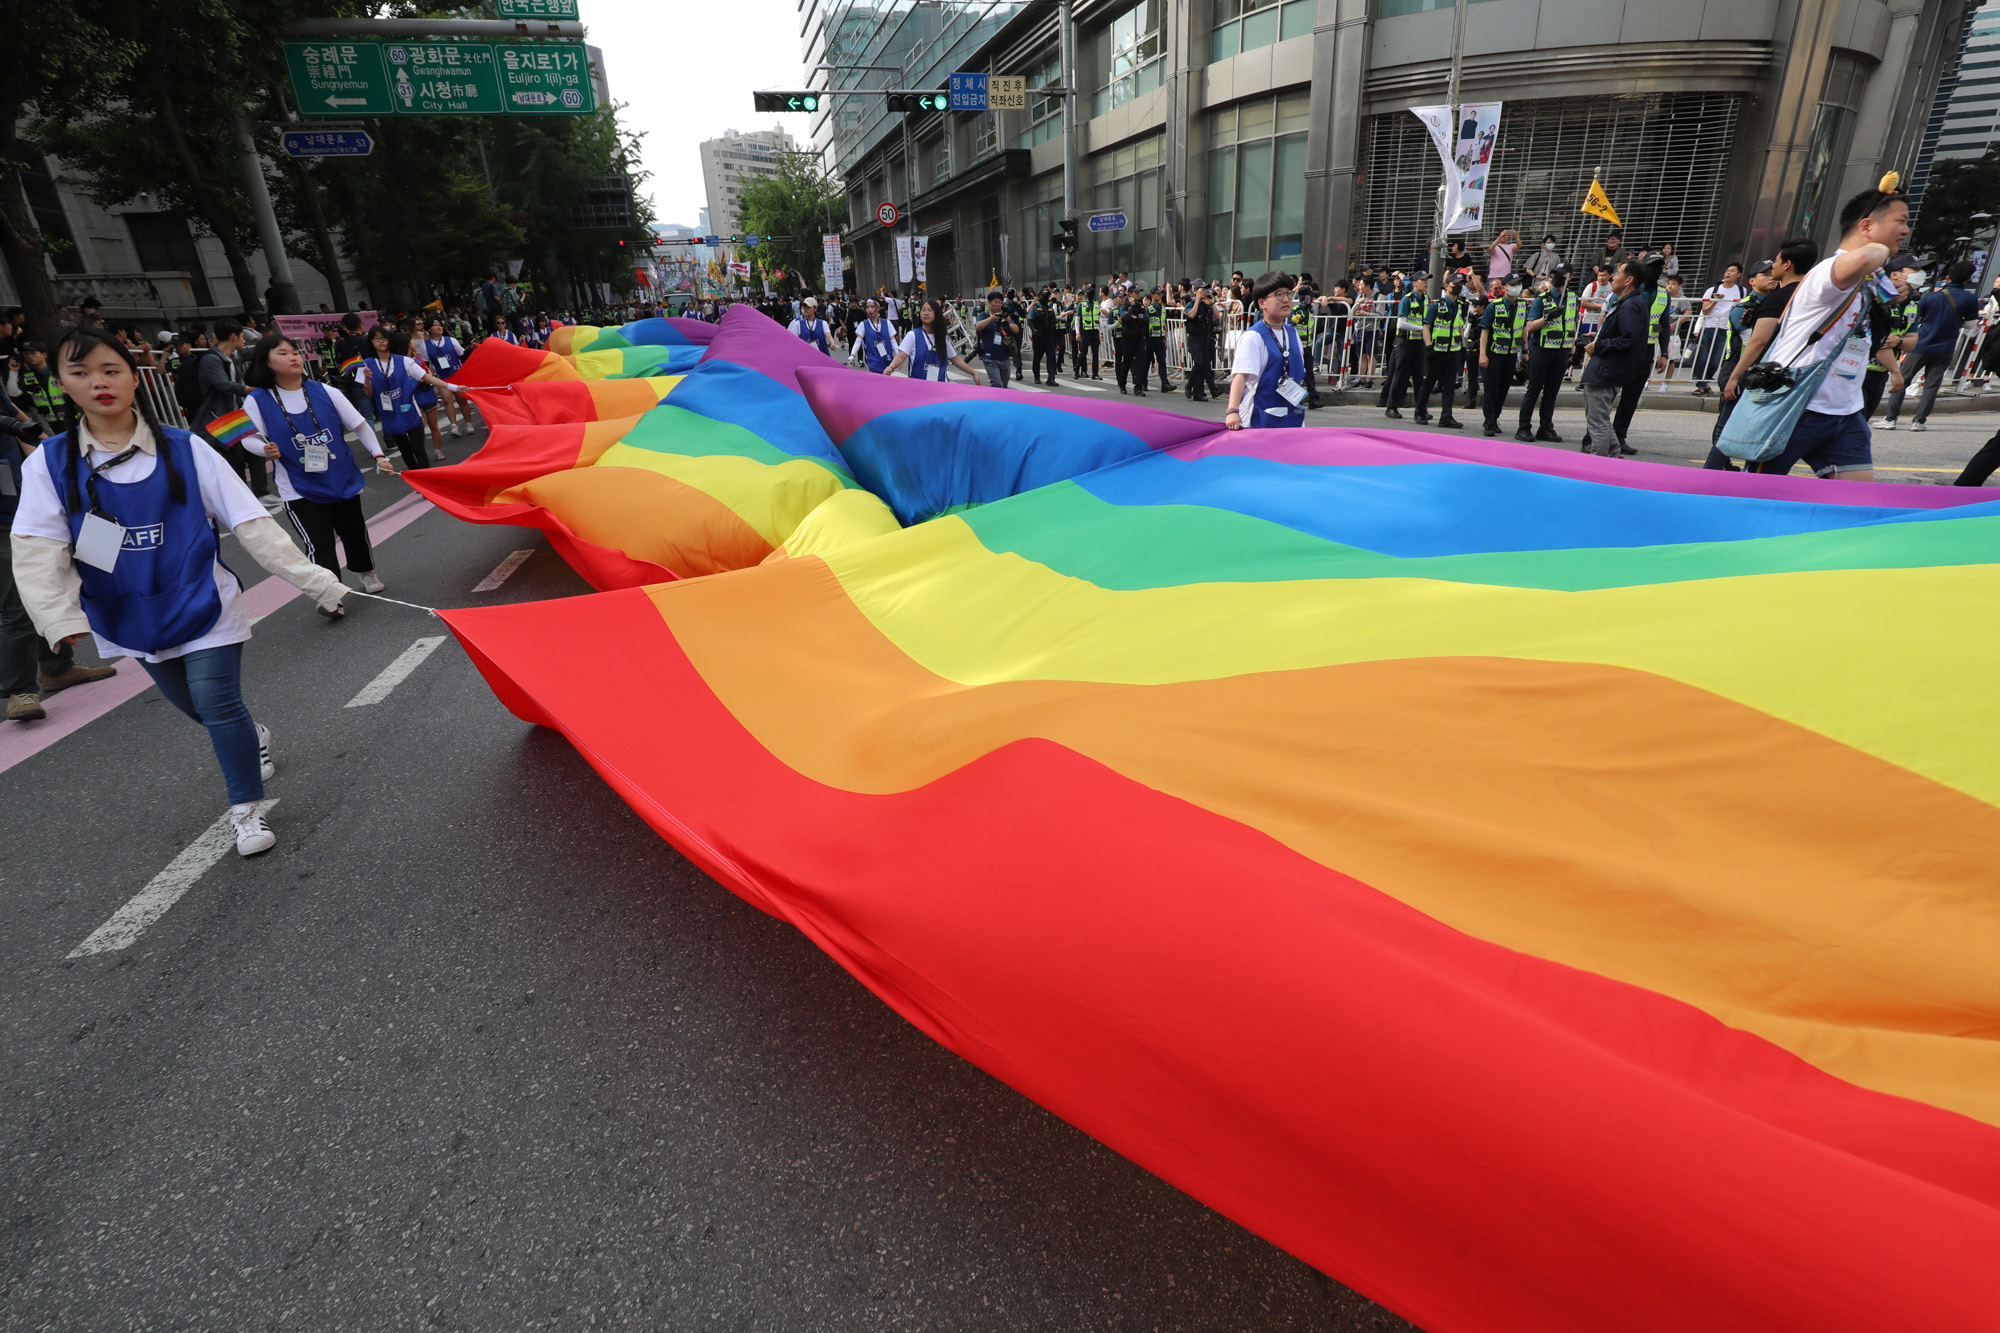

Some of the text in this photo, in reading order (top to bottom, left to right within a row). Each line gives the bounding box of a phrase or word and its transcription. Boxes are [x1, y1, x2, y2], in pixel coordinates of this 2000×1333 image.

[302, 46, 358, 64] 숭례문
[392, 49, 404, 61] 60
[409, 47, 492, 65] 광화문 光化門
[503, 51, 578, 71] 을지로1가
[306, 64, 352, 79] 崇禮門
[413, 65, 472, 77] Gwanghwamun
[311, 79, 369, 91] Sungnyemun
[508, 72, 579, 87] Euljiro 1(il)-ga
[400, 85, 411, 96] 31
[419, 81, 452, 99] 시청
[518, 94, 543, 103] 남대문로
[565, 92, 578, 104] 60
[952, 93, 986, 106] 진입금지
[990, 95, 1024, 107] 직좌신호
[422, 101, 467, 111] City Hall
[287, 140, 299, 149] 49
[304, 134, 346, 145] 남대문로
[355, 138, 367, 147] 53
[1586, 193, 1608, 213] 56-2
[881, 208, 895, 221] 50
